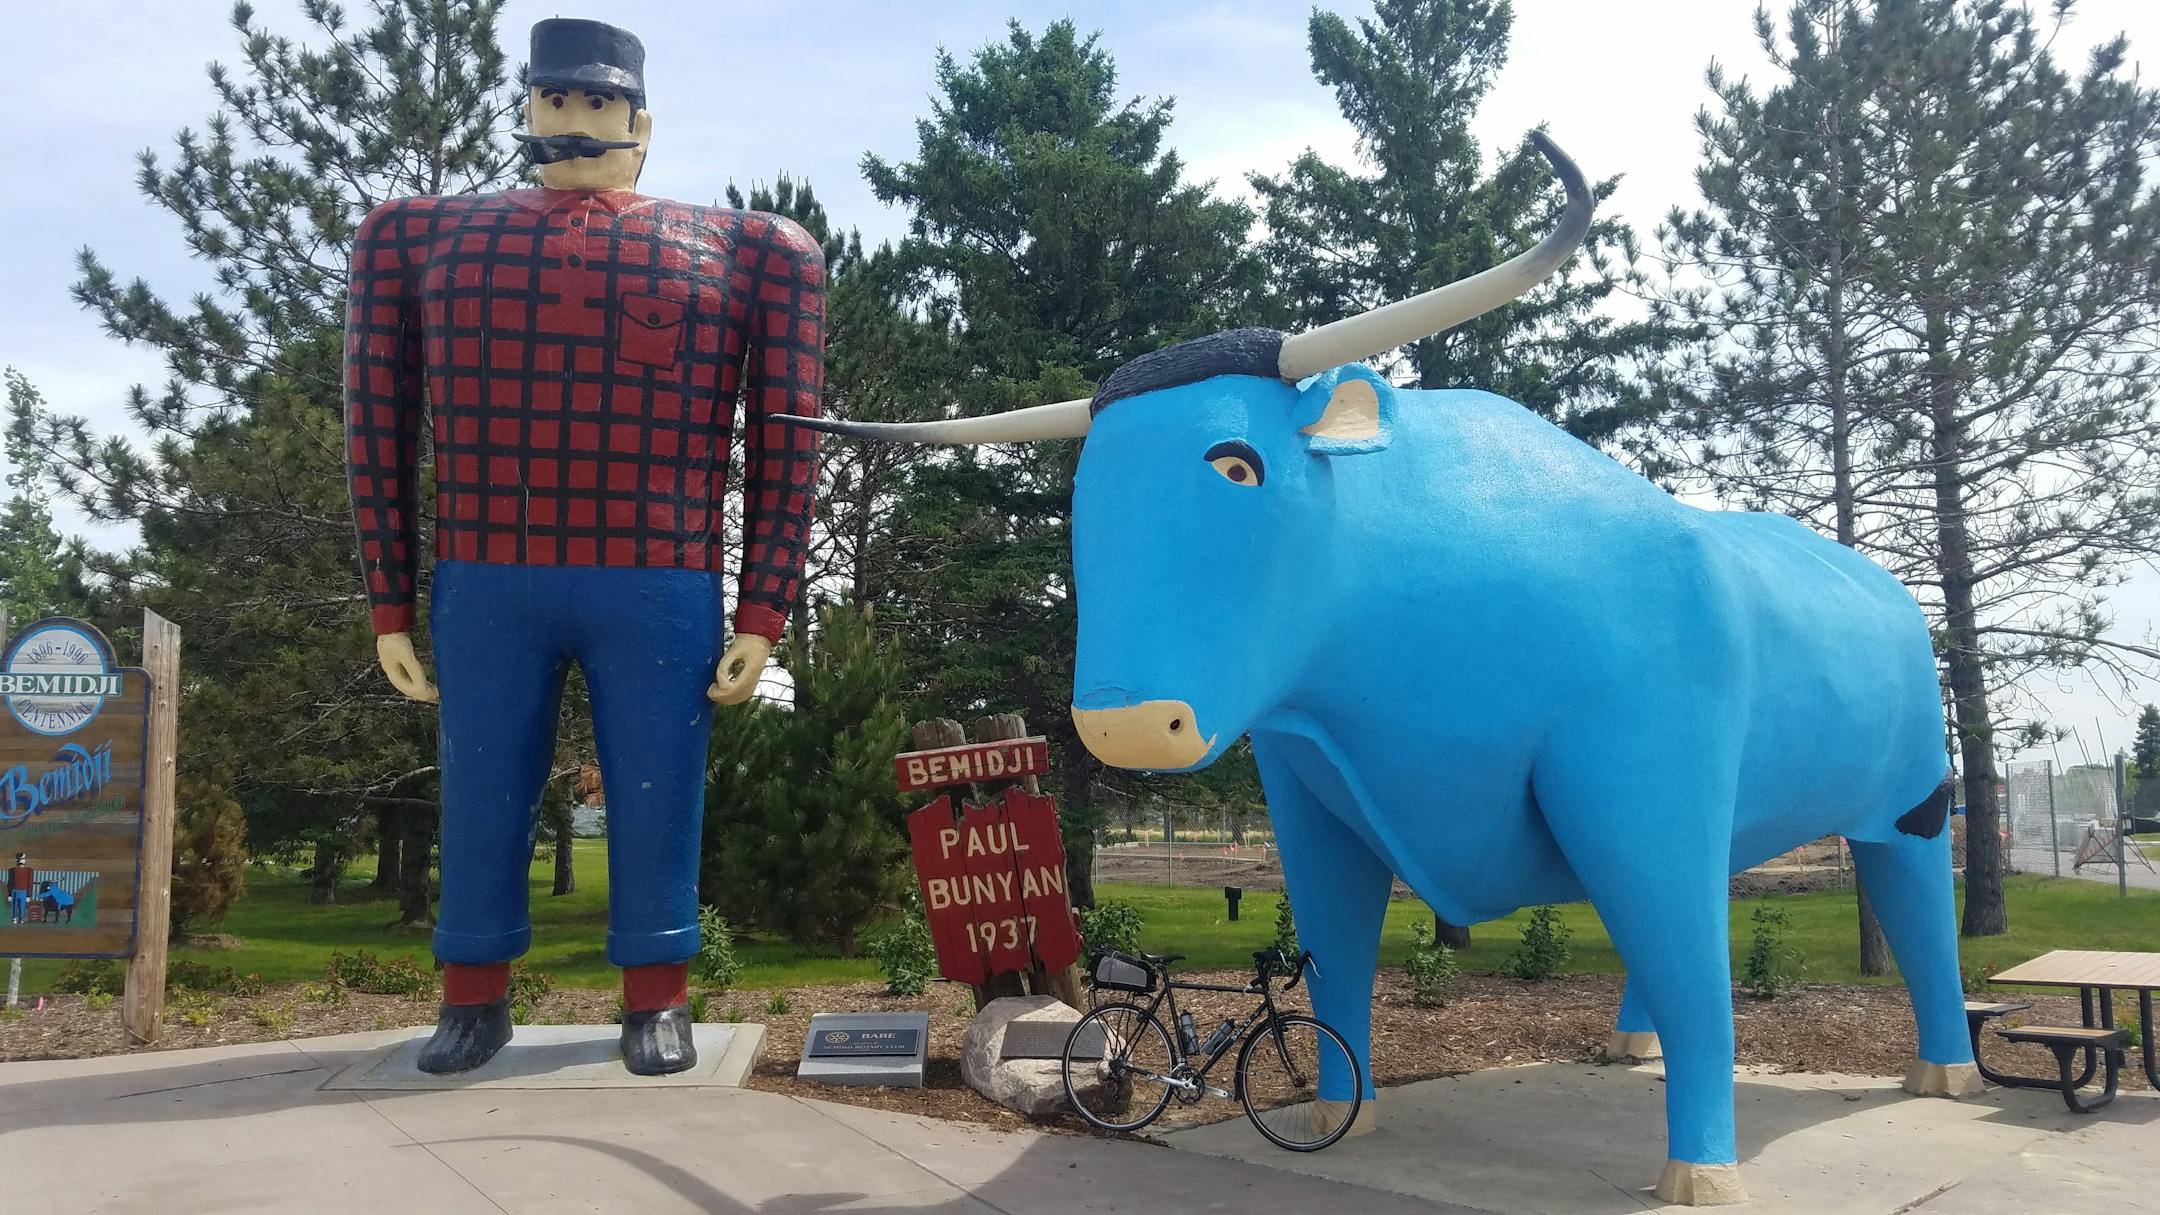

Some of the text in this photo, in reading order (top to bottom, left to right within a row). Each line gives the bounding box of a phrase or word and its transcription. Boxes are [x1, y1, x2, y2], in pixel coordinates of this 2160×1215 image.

[0, 675, 119, 695] BEMIDJI
[17, 699, 94, 729] CENTENNIAL
[0, 739, 112, 819] Bemidji
[907, 747, 1034, 786] BEMIDJI
[939, 821, 1030, 860] PAUL
[927, 864, 1064, 911] BUNYAN
[965, 915, 1037, 953] 1937
